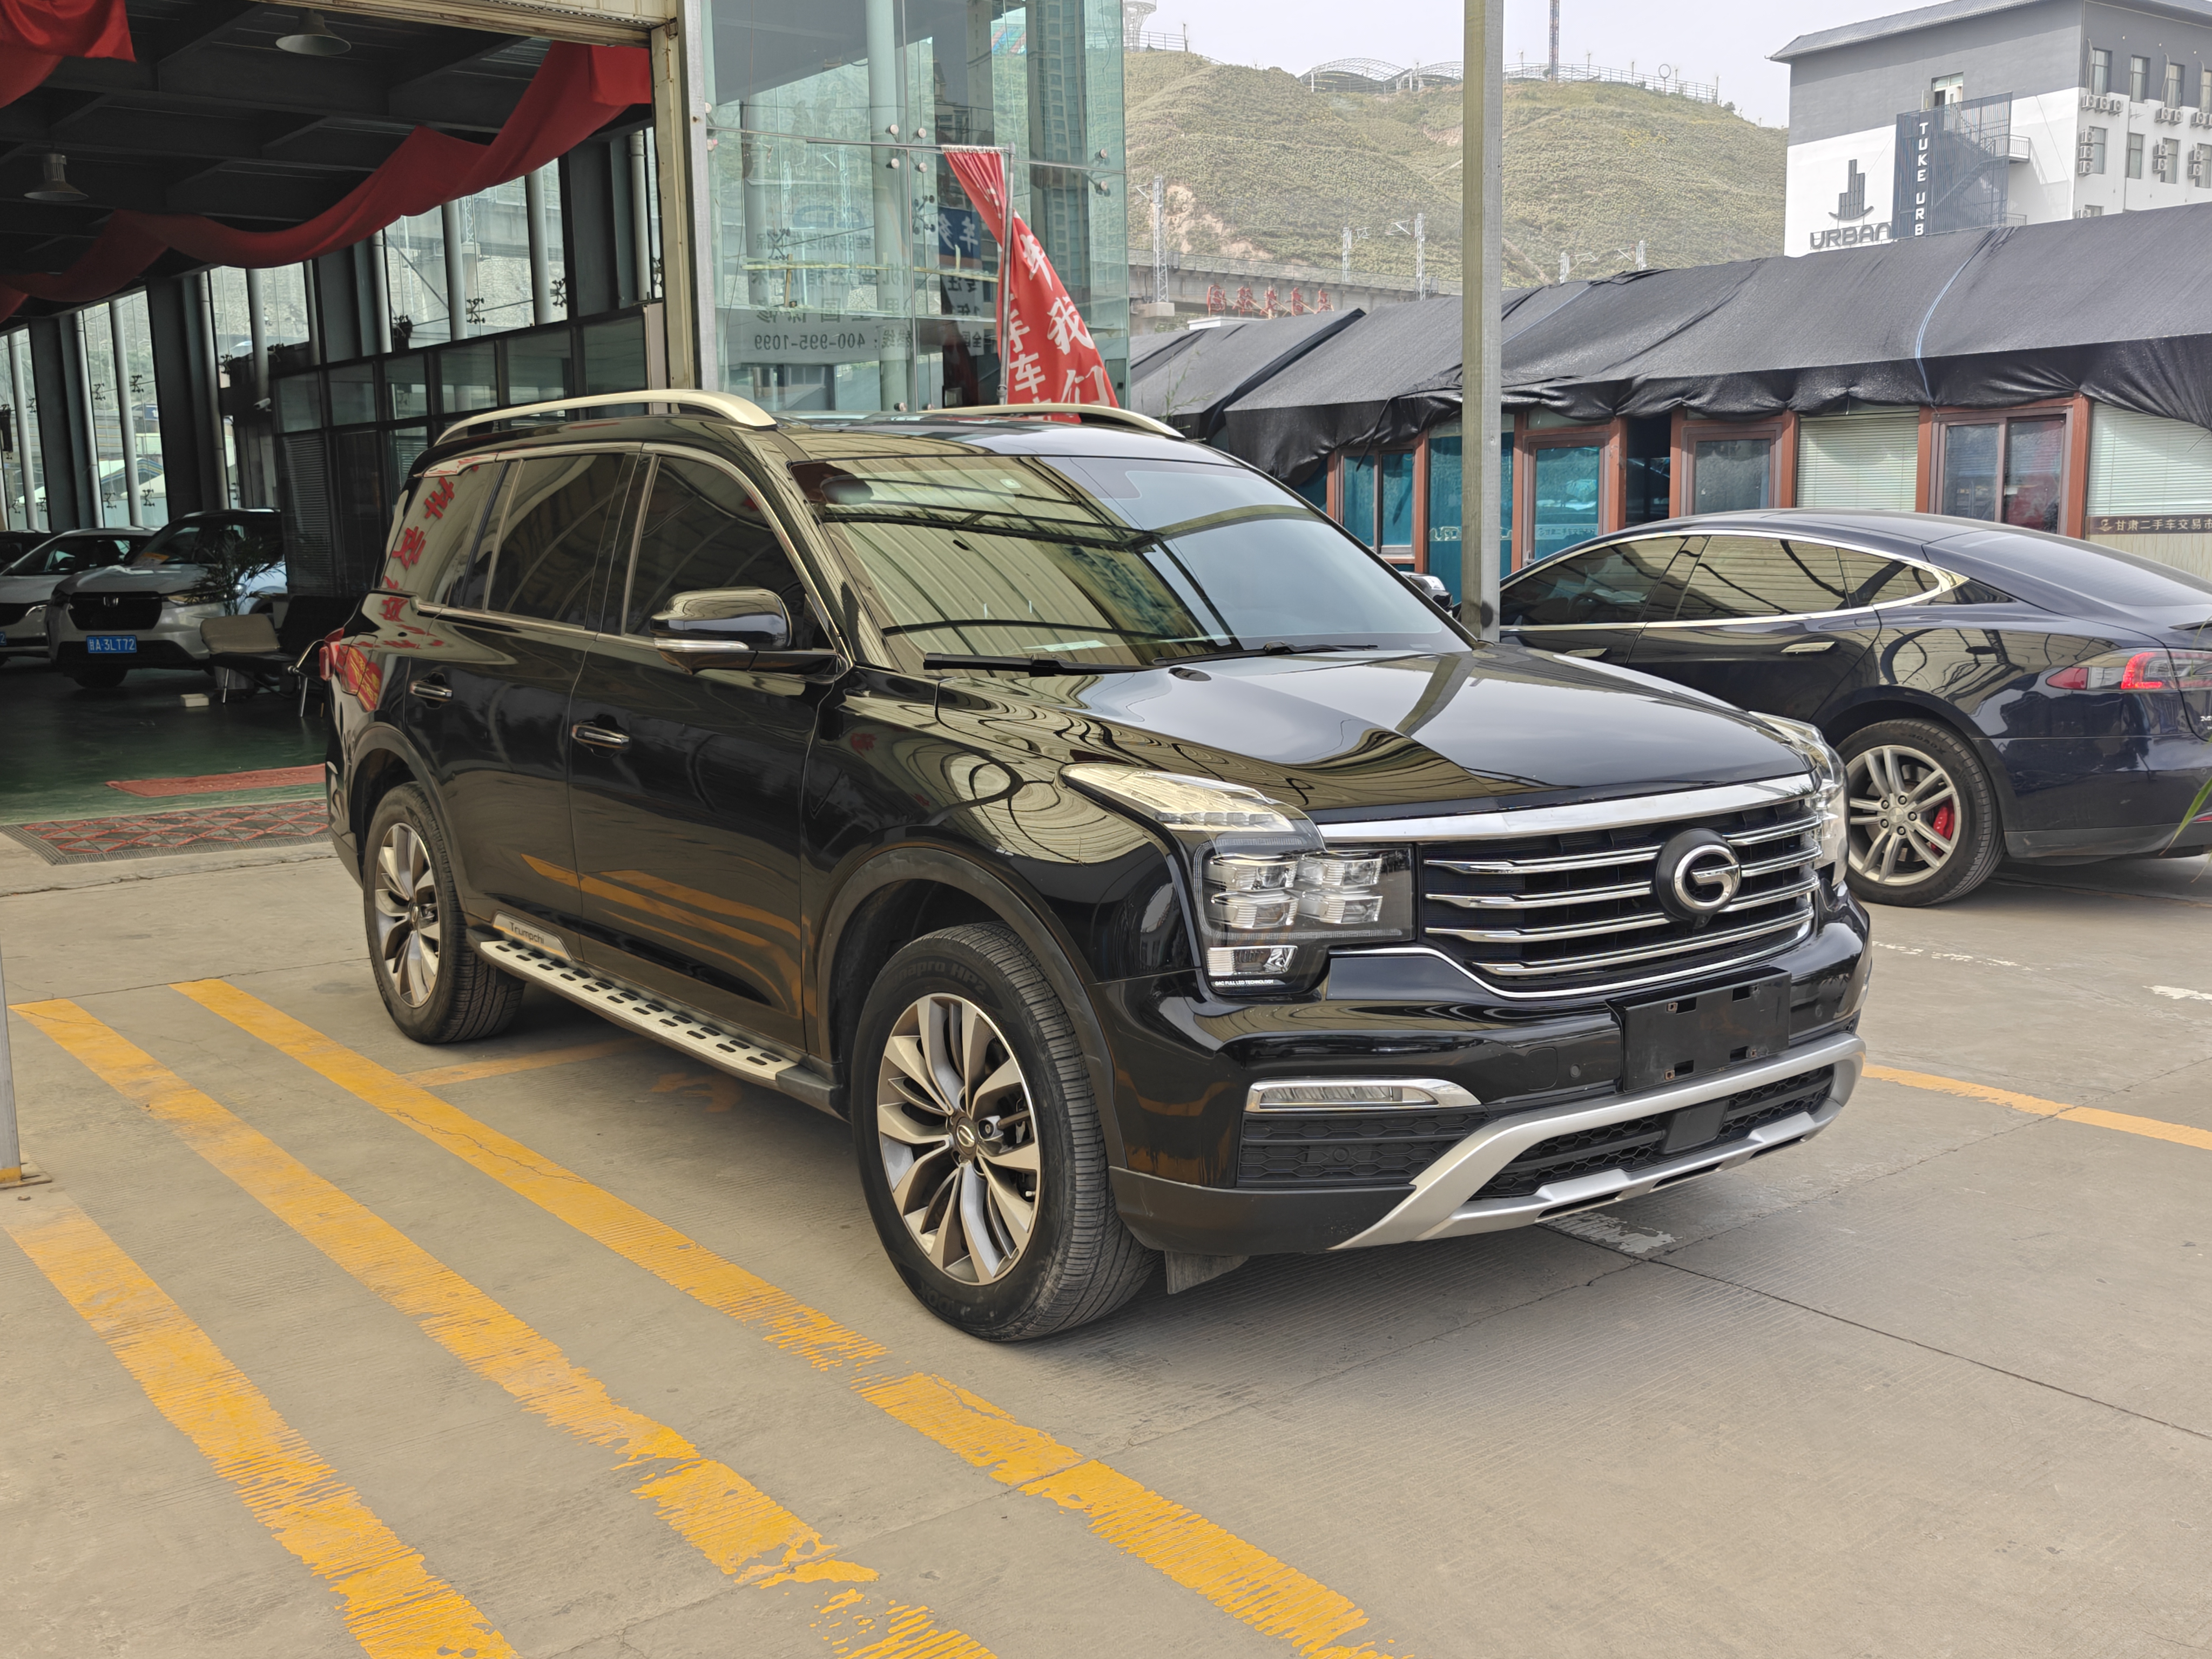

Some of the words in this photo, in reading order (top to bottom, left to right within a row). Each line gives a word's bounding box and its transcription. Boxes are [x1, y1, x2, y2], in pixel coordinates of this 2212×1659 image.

[1917, 122, 1928, 182] TUKE
[1810, 222, 1892, 249] URBAN
[509, 921, 544, 945] Trumpchi
